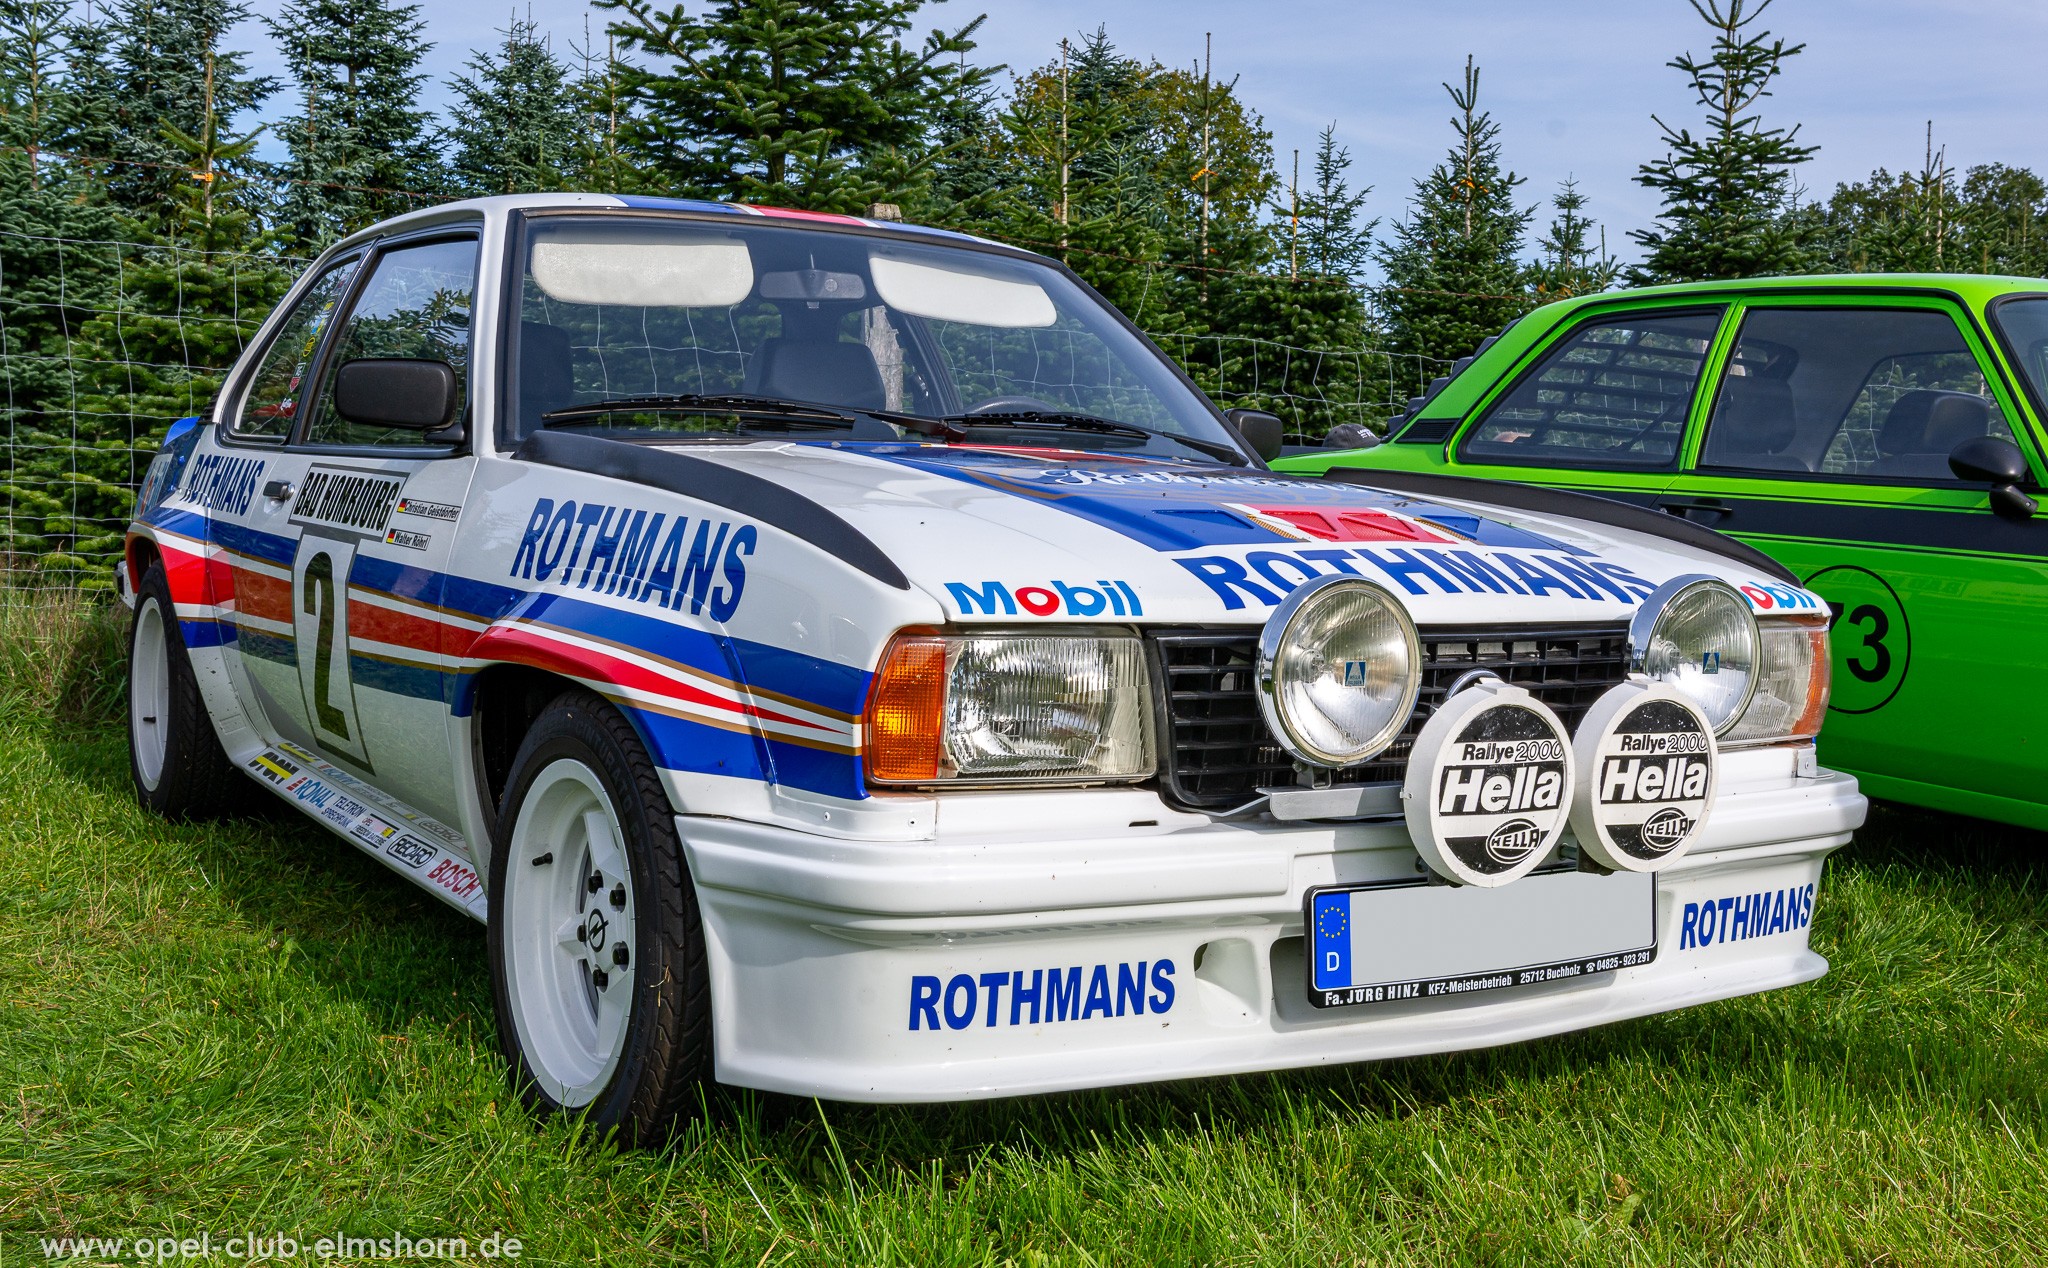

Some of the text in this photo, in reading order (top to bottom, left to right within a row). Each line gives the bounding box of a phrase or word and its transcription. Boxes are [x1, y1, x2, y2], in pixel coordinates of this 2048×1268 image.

[180, 454, 265, 516] ROTHMANS
[293, 472, 400, 531] BAD HOMBOURG
[404, 501, 428, 515] Christian
[394, 531, 413, 546] Walter
[510, 498, 758, 623] ROTHMANS
[944, 581, 1143, 616] Mobil
[1741, 581, 1816, 609] obil
[304, 552, 350, 741] 2
[1462, 743, 1514, 763] Rallye
[1620, 734, 1667, 753] Rallye
[297, 779, 337, 809] RONAL
[1440, 766, 1562, 813] Hella
[1601, 757, 1708, 801] Hella
[1491, 829, 1540, 848] HELLA
[1646, 818, 1688, 836] HELLA
[390, 838, 433, 866] RECARO
[427, 859, 480, 899] BOSCH
[1680, 883, 1813, 950] ROTHMANS
[1325, 992, 1344, 1006] Fa.
[1347, 987, 1383, 1003] JÖRG
[1387, 984, 1419, 1000] HINZ
[1428, 976, 1512, 996] KFZ-Meisterbetrieb
[1520, 970, 1545, 984] 25712
[1546, 964, 1581, 980] Buchholz
[1637, 950, 1650, 963] 291
[1326, 952, 1340, 972] D
[908, 958, 1175, 1031] ROTHMANS
